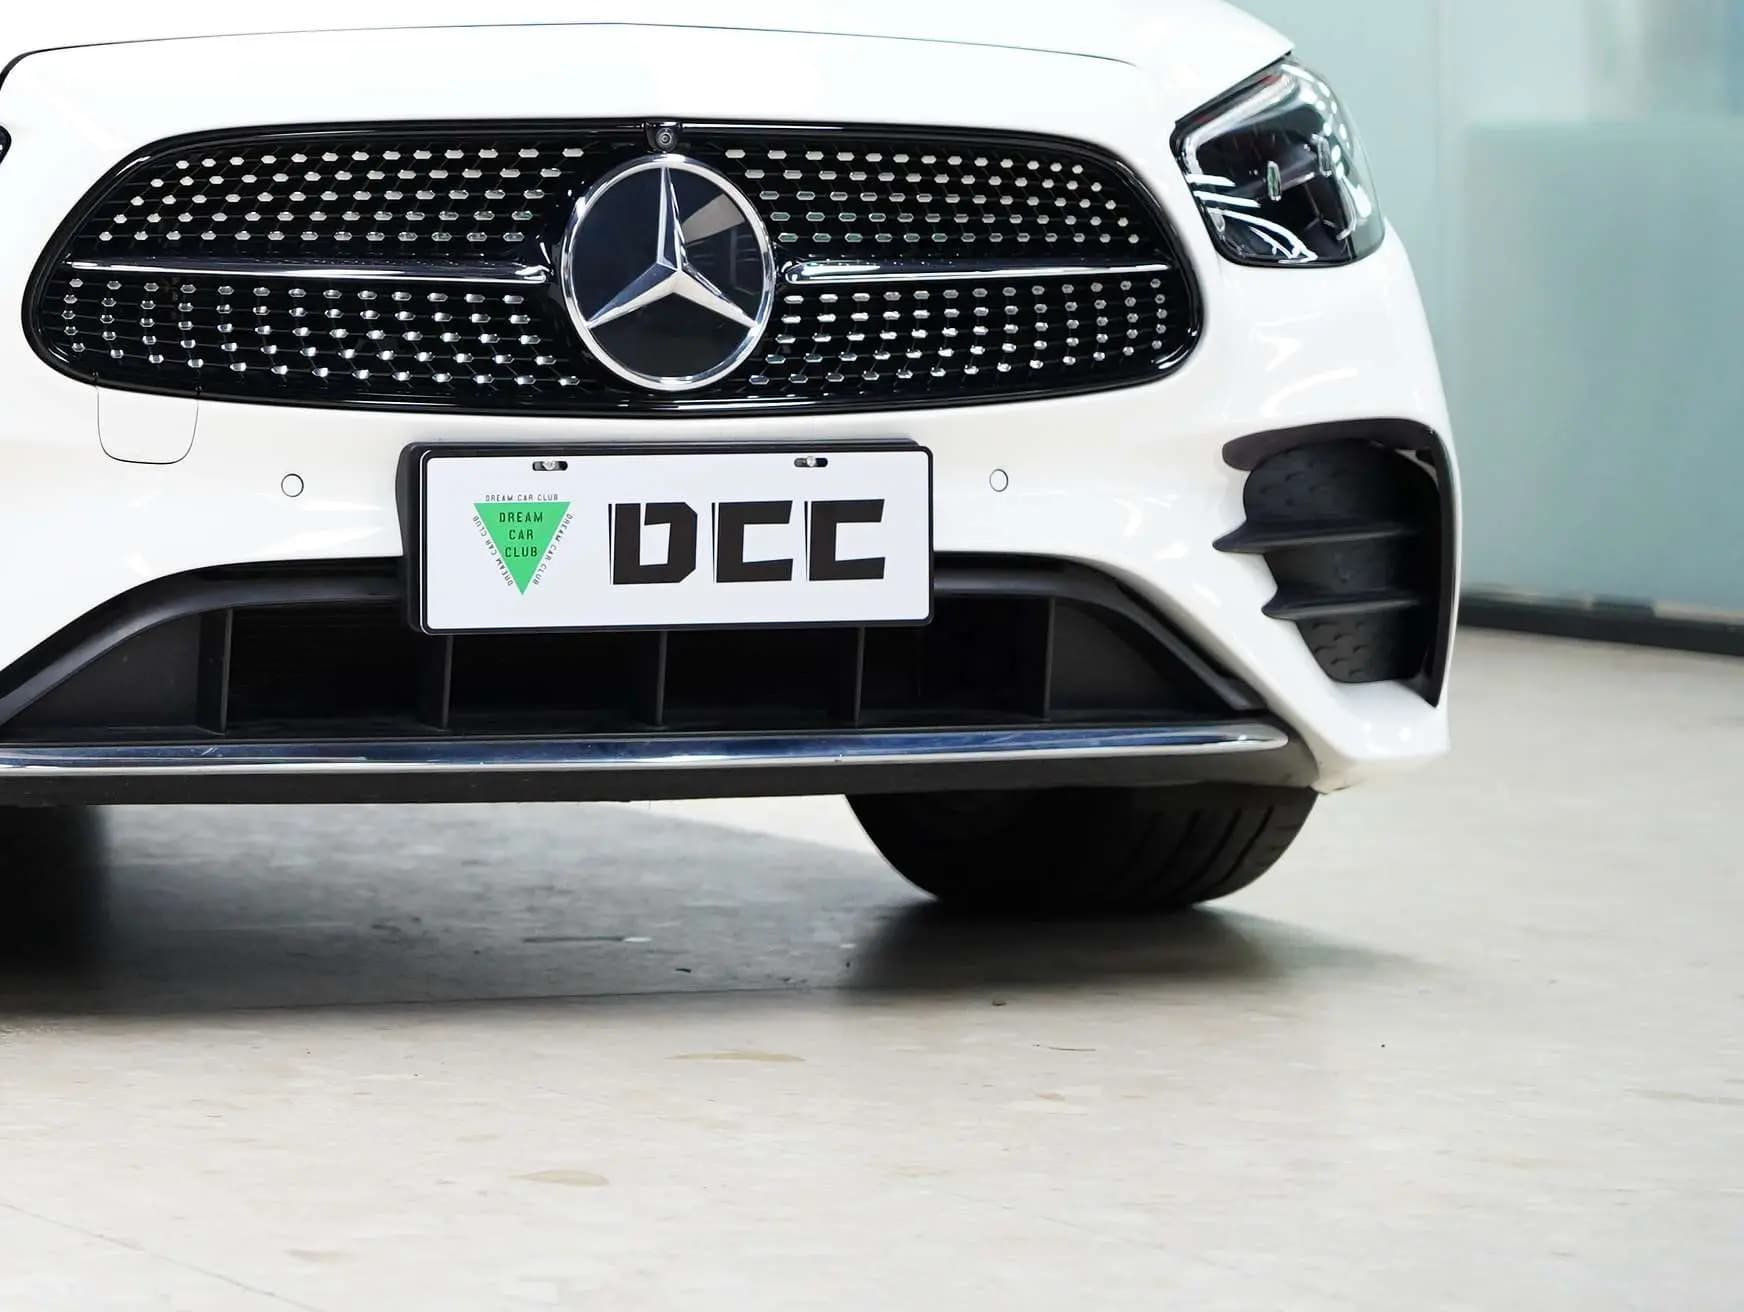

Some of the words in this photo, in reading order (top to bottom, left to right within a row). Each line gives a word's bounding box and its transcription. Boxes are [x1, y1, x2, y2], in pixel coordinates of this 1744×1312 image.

[485, 494, 513, 502] DREAM
[517, 494, 534, 502] CAR
[537, 493, 559, 501] CLUB
[499, 511, 543, 523] DREAM
[508, 529, 534, 540] CAR
[608, 499, 886, 585] DCC
[504, 546, 538, 558] CLUB
